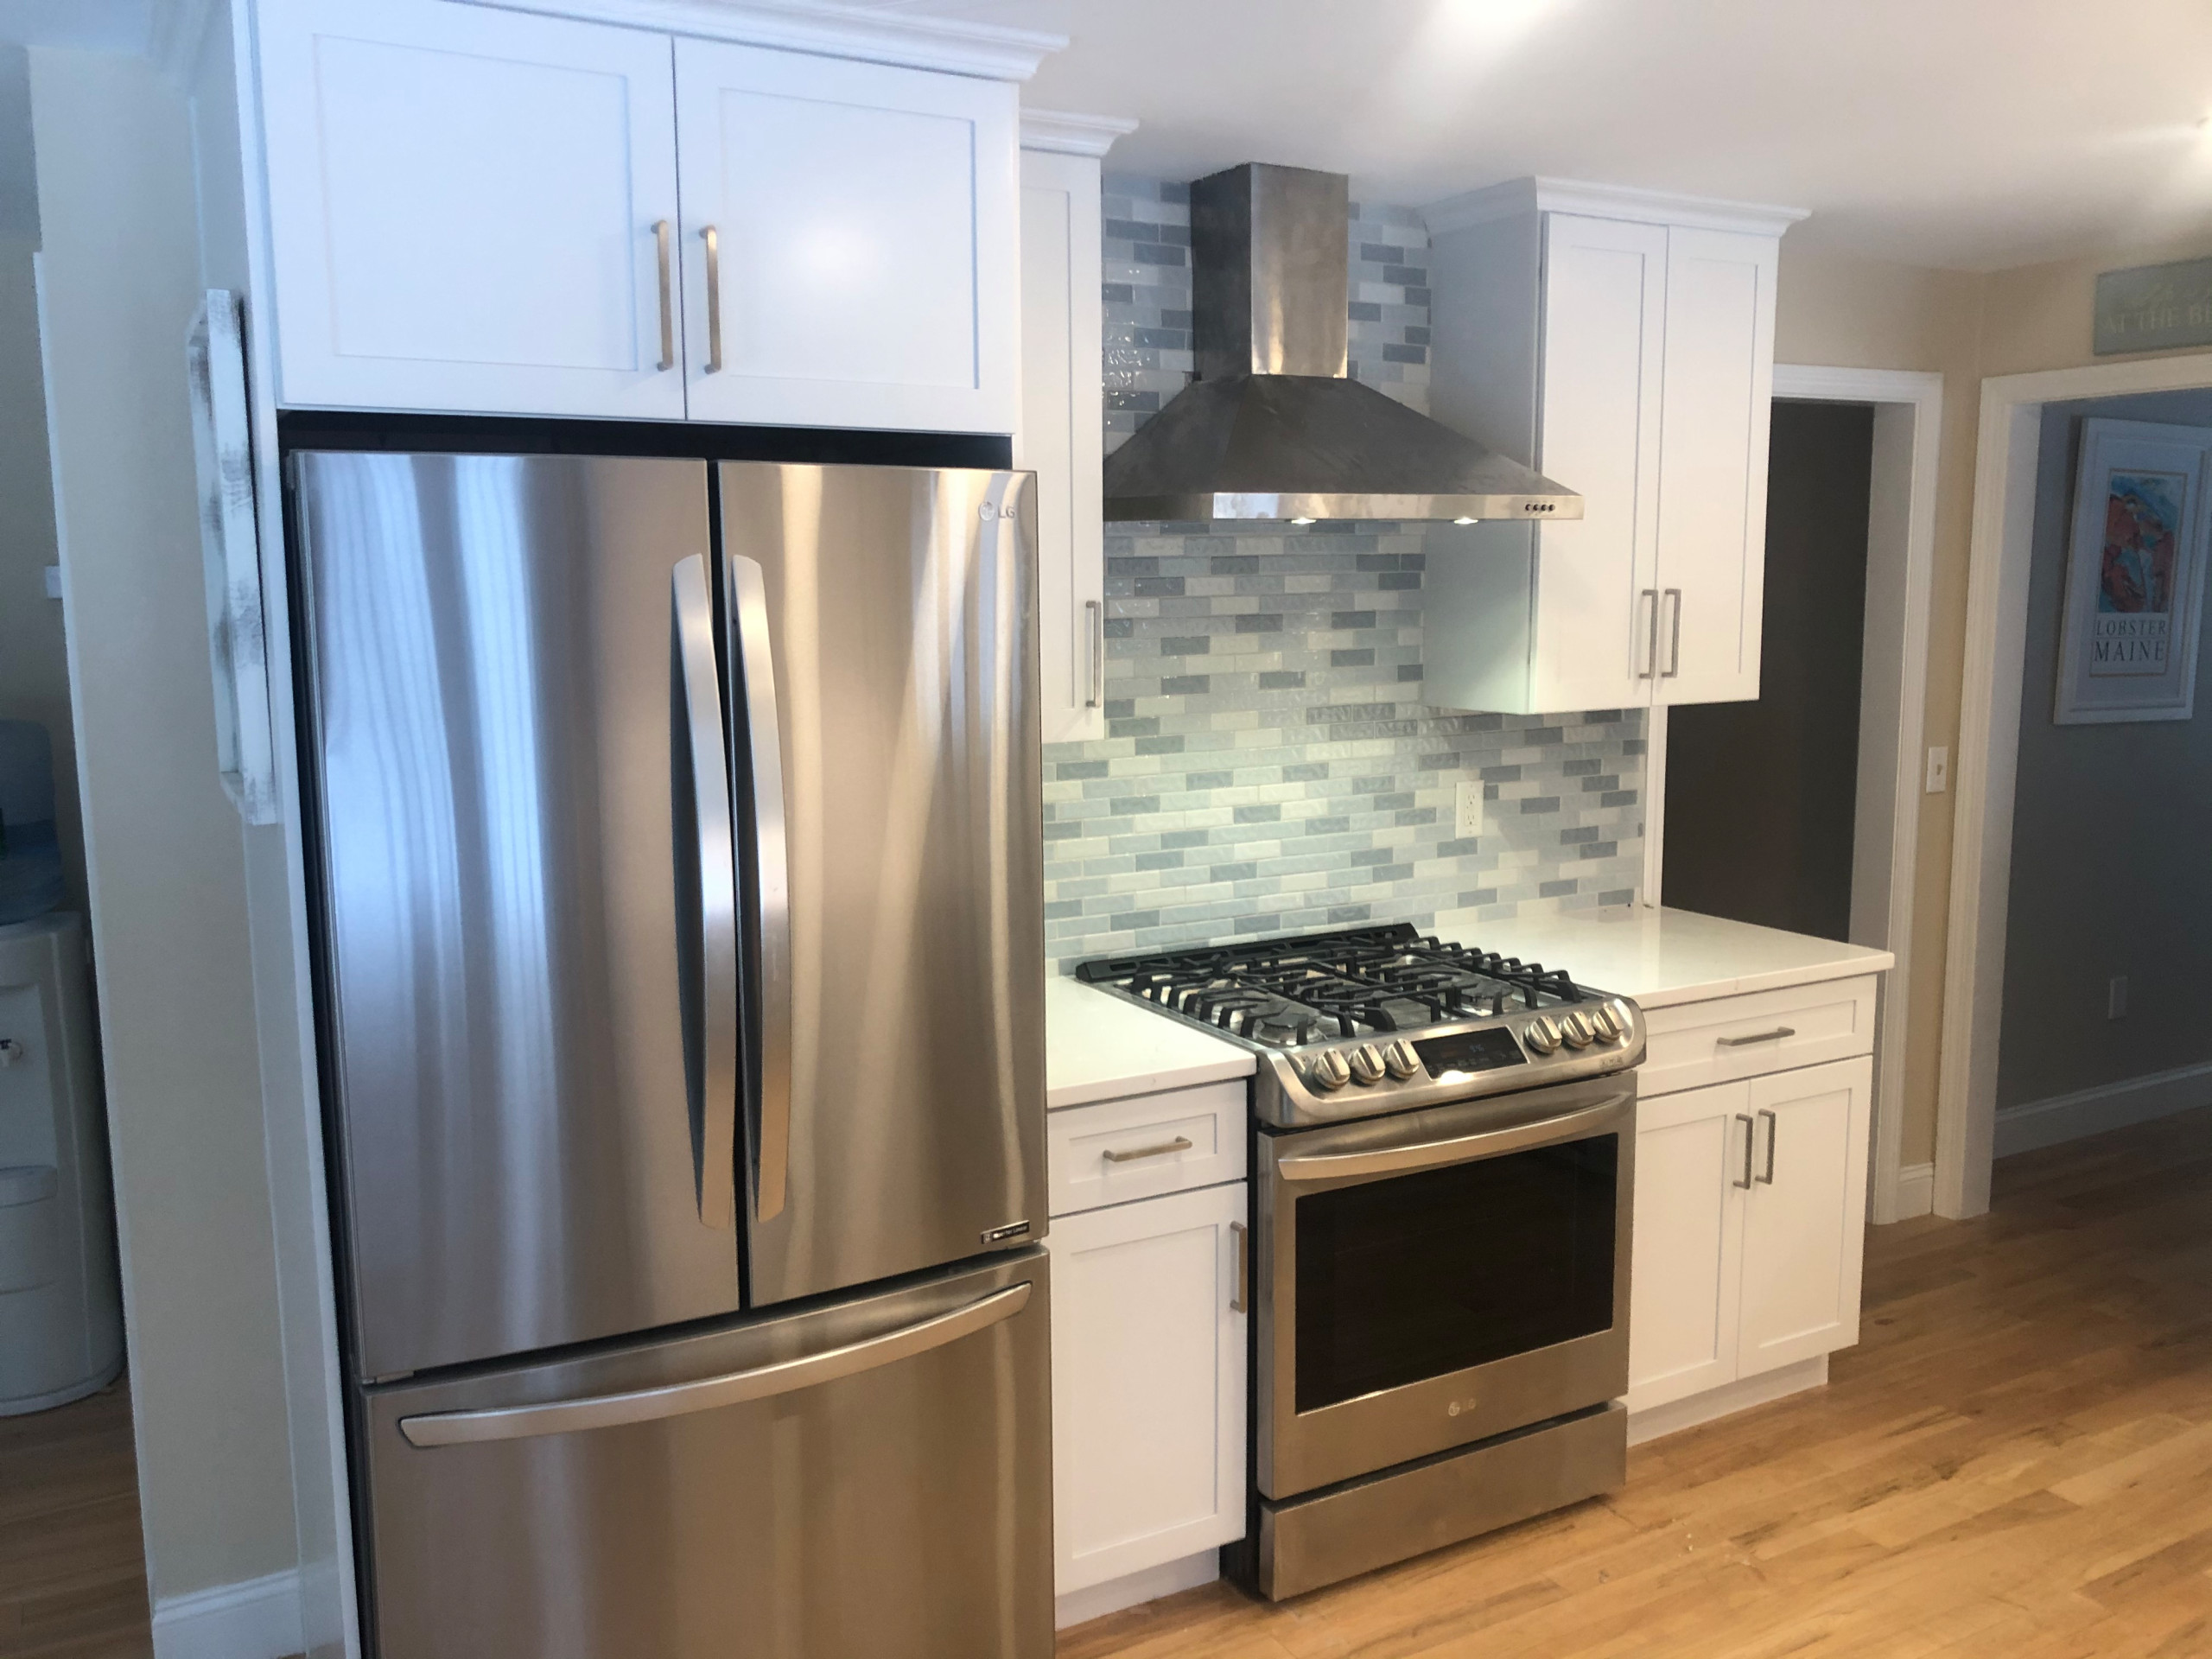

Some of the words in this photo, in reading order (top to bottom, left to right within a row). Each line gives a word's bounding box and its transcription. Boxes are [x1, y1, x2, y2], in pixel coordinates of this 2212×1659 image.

[2136, 308, 2179, 332] THE
[998, 505, 1015, 518] LG
[2096, 619, 2165, 636] LOBSTER
[2094, 641, 2165, 662] MAINE
